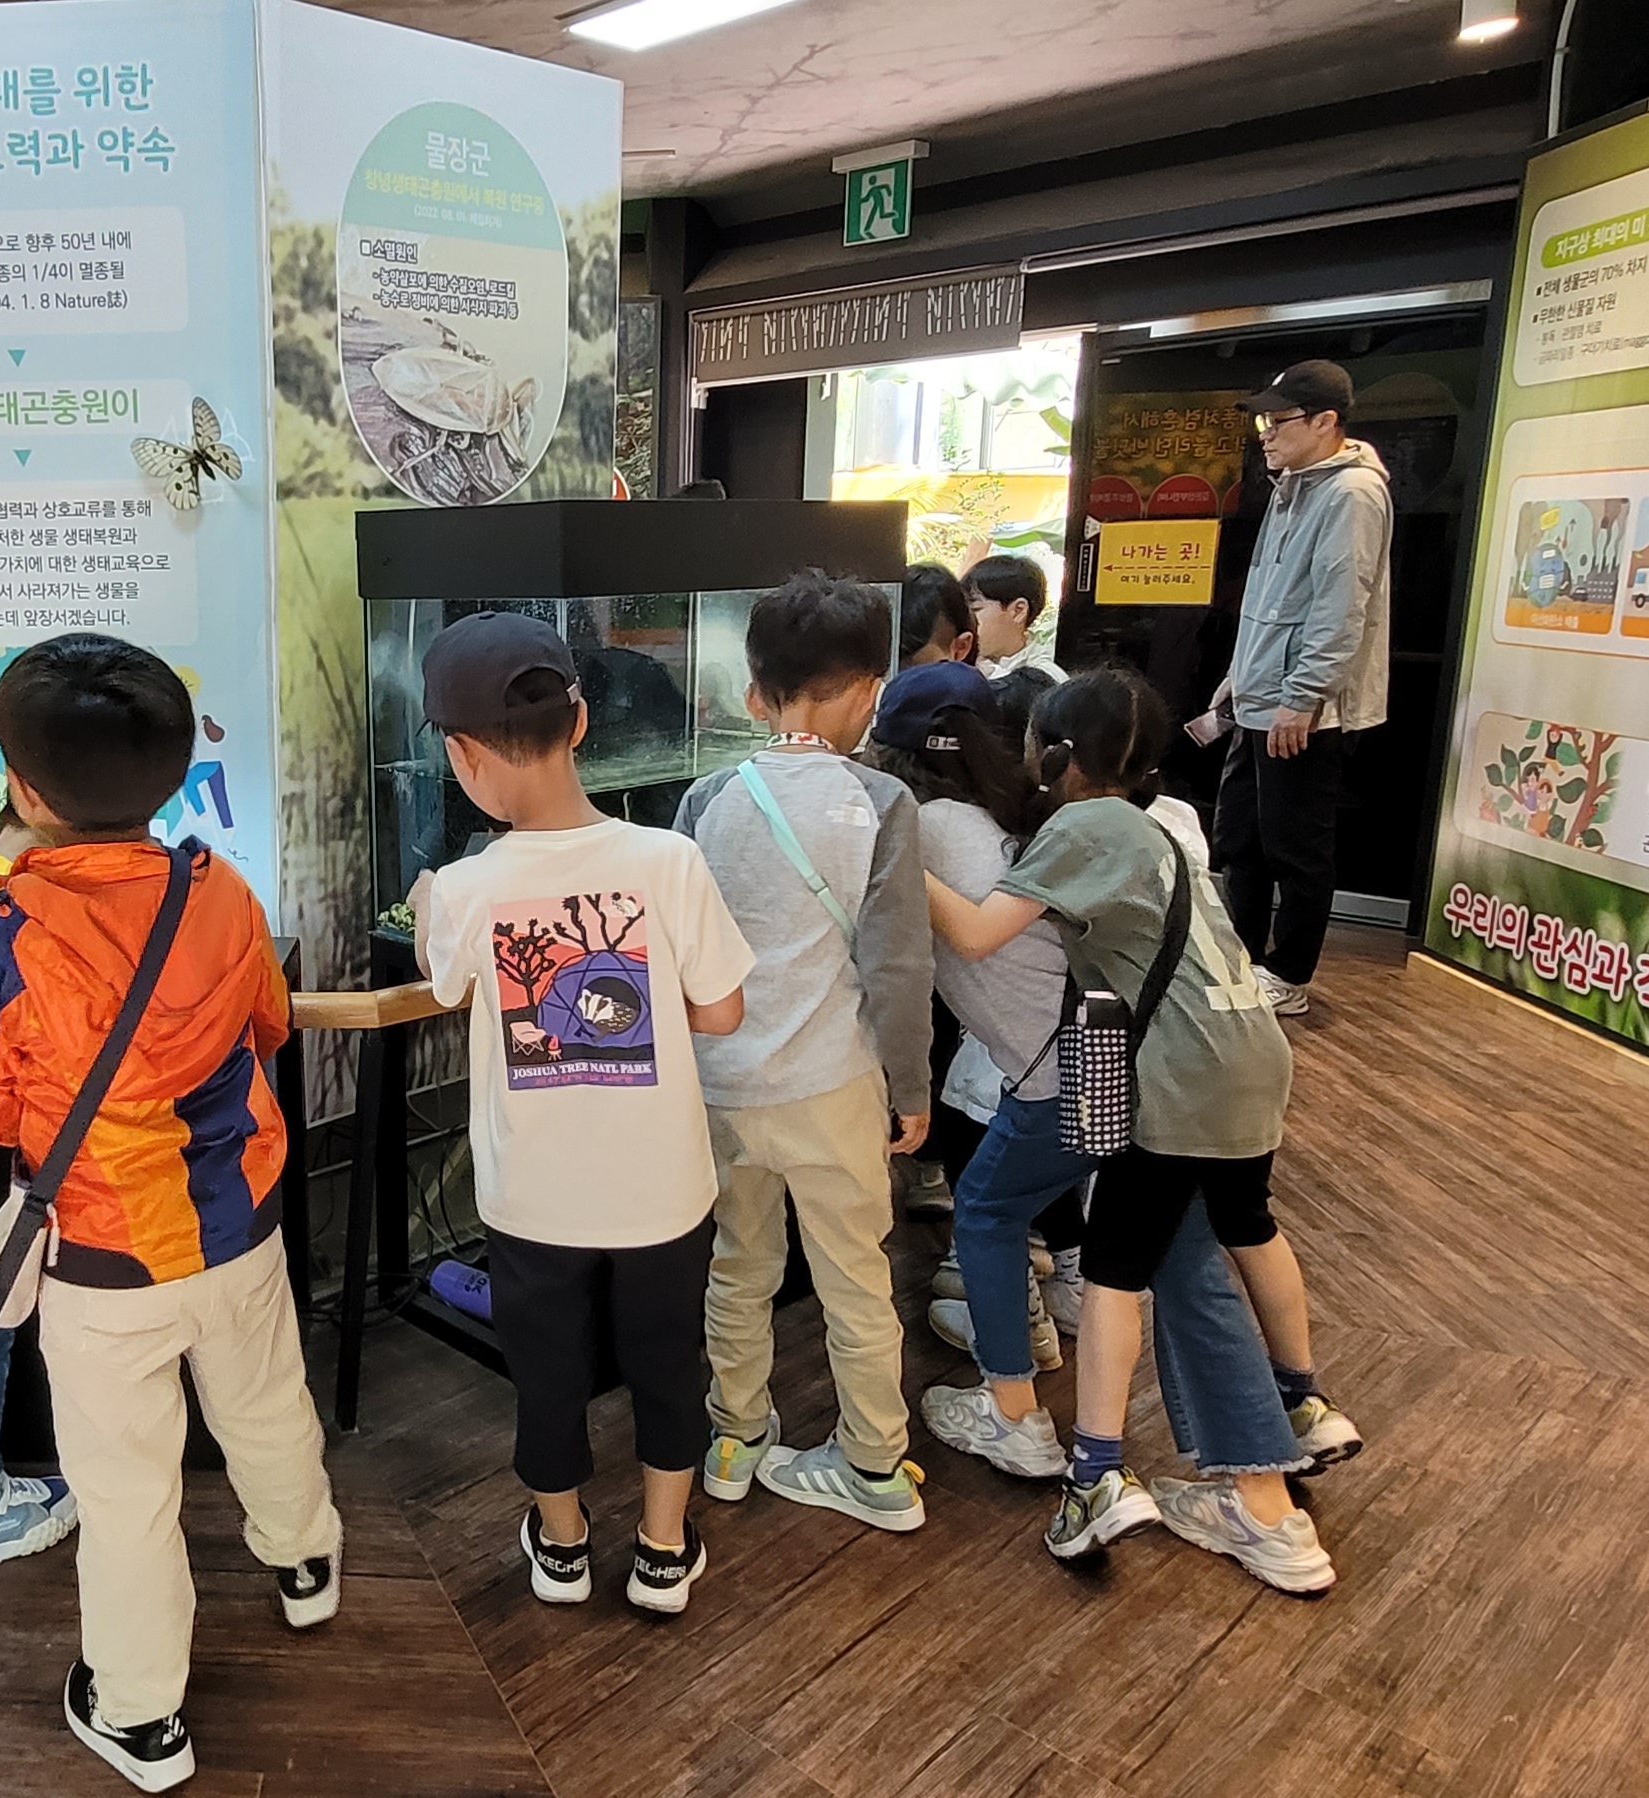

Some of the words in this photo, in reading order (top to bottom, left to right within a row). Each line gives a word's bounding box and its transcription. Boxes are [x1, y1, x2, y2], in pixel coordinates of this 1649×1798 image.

[73, 63, 154, 111] 위한
[97, 125, 175, 173] 약속
[425, 130, 491, 177] 물장군
[25, 233, 56, 253] 향후
[61, 231, 96, 251] 50년
[102, 230, 132, 250] 내에
[372, 239, 418, 264] 소멸원인
[1555, 231, 1590, 259] 지구상
[32, 262, 73, 282] 1/4이
[79, 261, 125, 281] 멸종될
[1601, 262, 1624, 282] 70%
[40, 293, 50, 310] 8
[42, 501, 116, 519] 상호교류를
[121, 500, 152, 518] 통해
[29, 528, 58, 546] 생물
[63, 527, 137, 546] 생태복원과
[1122, 543, 1167, 560] 나가는
[1178, 543, 1201, 560] 곳!
[0, 556, 43, 574] 가치에
[48, 555, 77, 573] 대한
[81, 554, 170, 573] 생태교육으로
[17, 582, 91, 600] 사라져가는
[95, 582, 139, 600] 생물을
[23, 609, 130, 628] 앞장서겠습니다.
[1444, 883, 1529, 961] 우리의
[1528, 913, 1631, 1002] 관심과
[513, 1065, 557, 1080] JOSHUA
[559, 1062, 589, 1074] TREE
[620, 1063, 652, 1074] PARK
